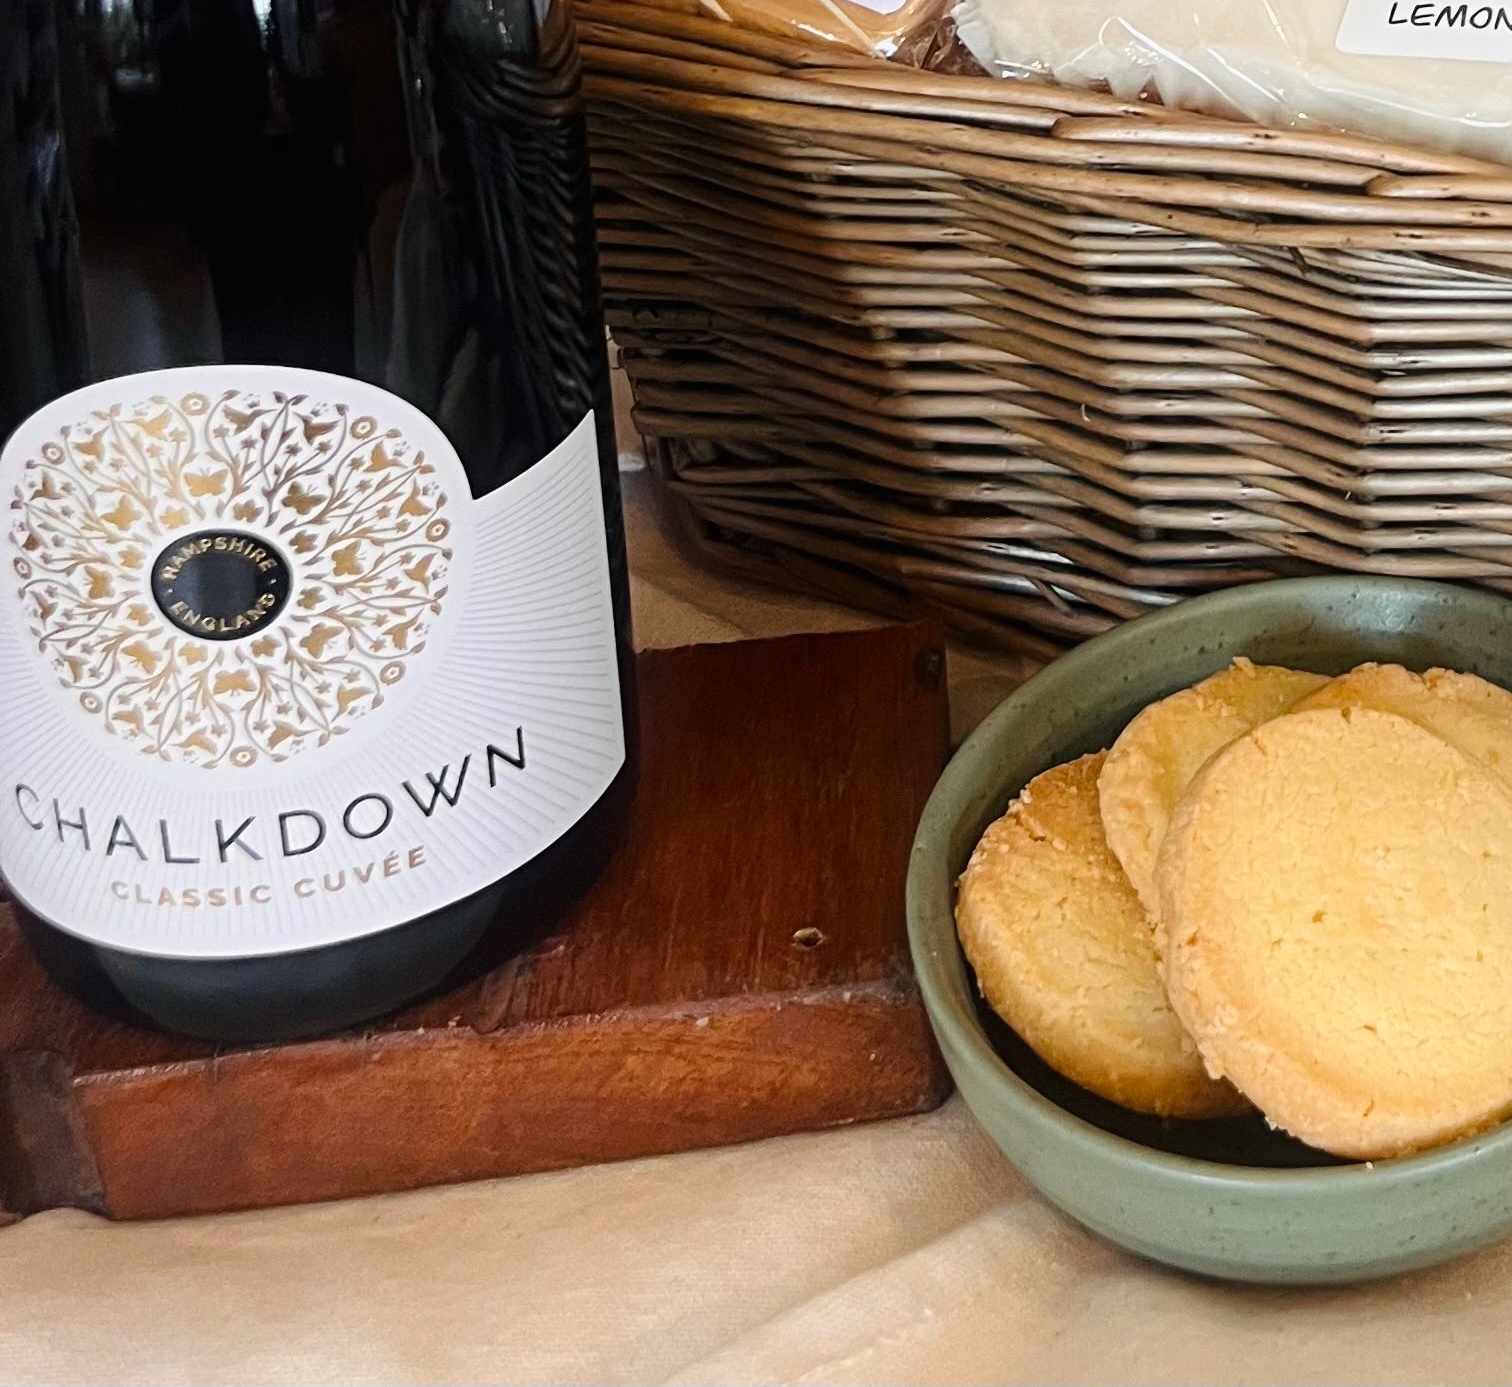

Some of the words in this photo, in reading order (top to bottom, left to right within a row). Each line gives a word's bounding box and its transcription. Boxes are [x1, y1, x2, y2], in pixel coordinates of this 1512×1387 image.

[160, 536, 278, 580] HAMPSHIRE
[168, 592, 276, 633] ENGLAND
[14, 725, 529, 867] CHALKDOWN
[110, 878, 273, 909] CLASSIC
[294, 844, 429, 900] CUVÉE
